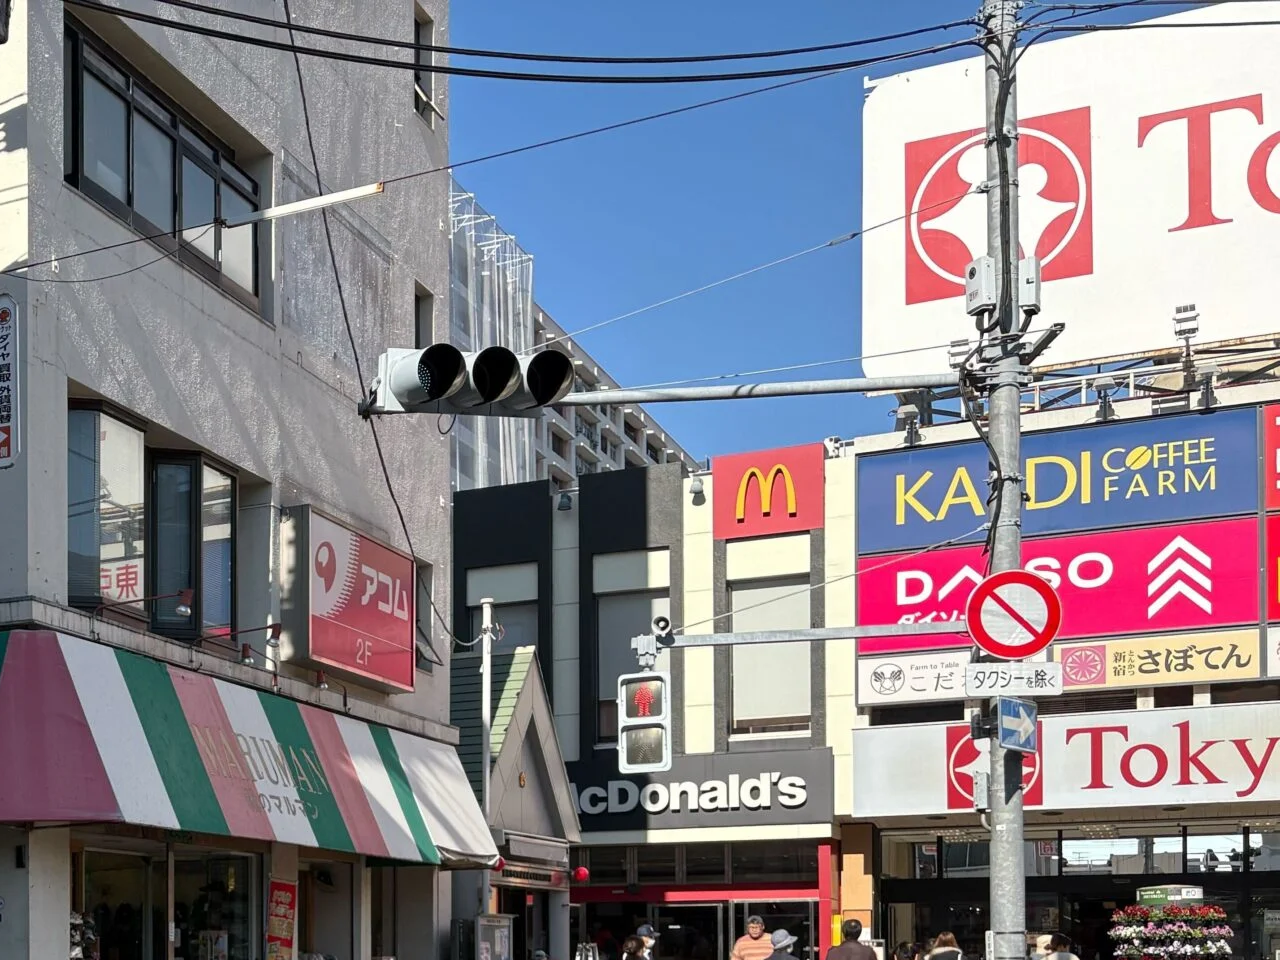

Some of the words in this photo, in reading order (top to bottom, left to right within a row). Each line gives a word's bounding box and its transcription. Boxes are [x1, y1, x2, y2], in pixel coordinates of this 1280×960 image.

[894, 450, 1091, 526] KADI
[1101, 437, 1216, 472] COFFEE
[1103, 466, 1217, 502] FARM
[361, 564, 409, 622] アコム
[896, 551, 1114, 606] DASO
[356, 638, 373, 665] 2F
[910, 663, 929, 671] Farm
[1112, 651, 1126, 677] 新宿
[1127, 650, 1136, 676] とんかつ
[1137, 643, 1252, 675] さぼてん
[910, 672, 966, 692] こだ
[973, 669, 1056, 689] タクシーを除く
[191, 724, 330, 795] MARUMAN
[1065, 719, 1280, 798] Toky
